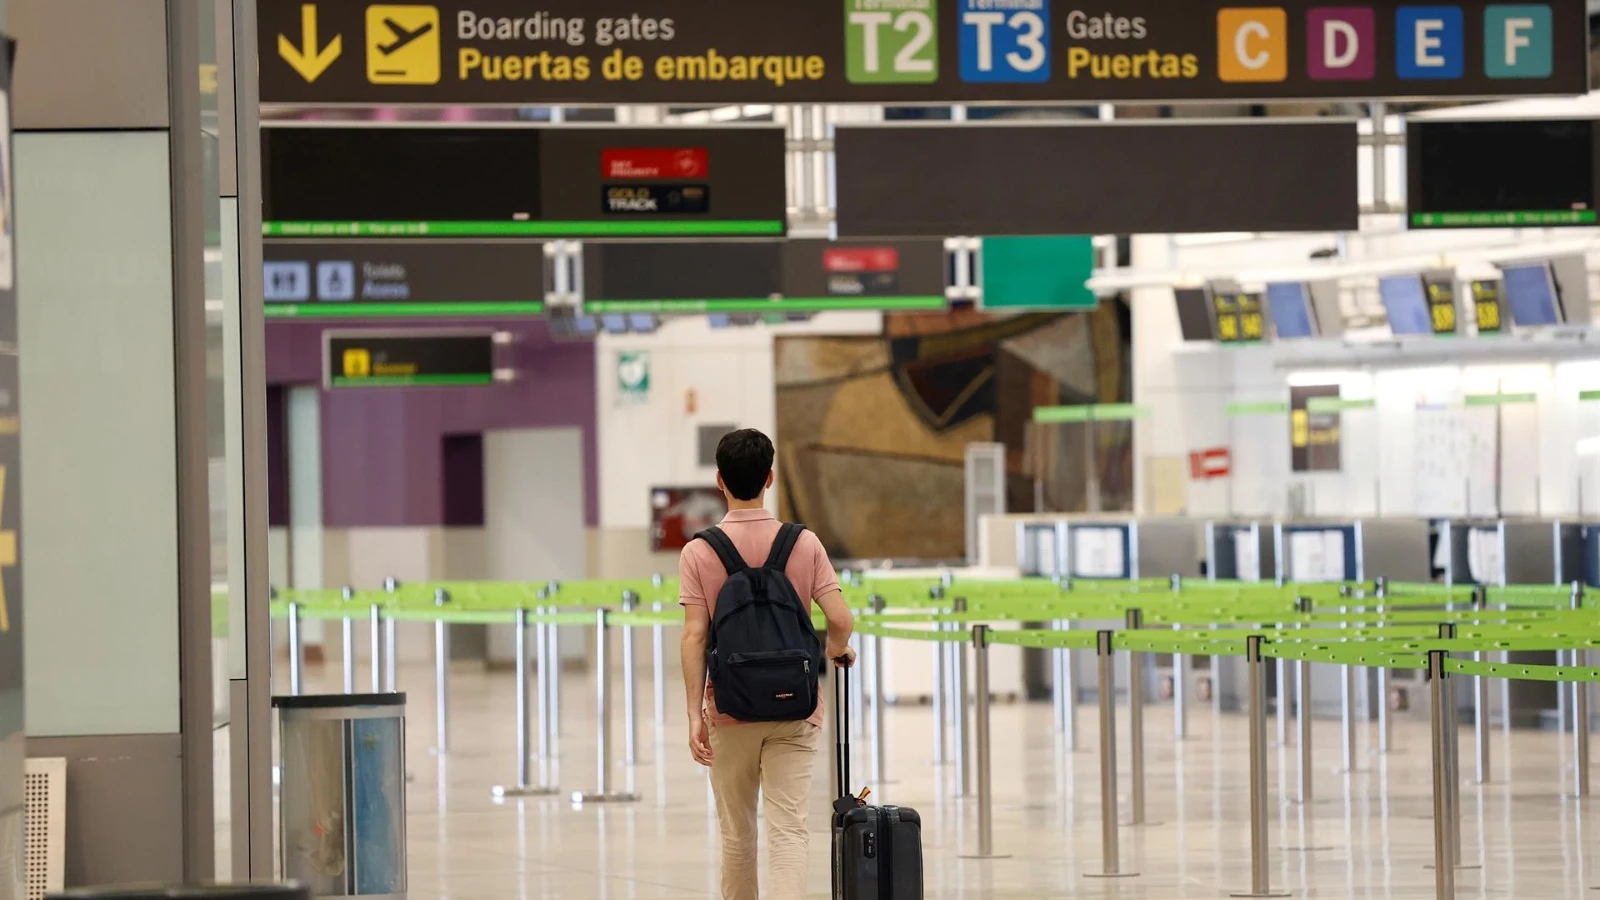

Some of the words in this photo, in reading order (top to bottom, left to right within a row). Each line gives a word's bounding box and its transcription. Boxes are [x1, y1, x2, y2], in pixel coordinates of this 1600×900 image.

[457, 10, 586, 46] Boarding
[595, 12, 676, 46] gates
[849, 10, 934, 73] T2
[963, 11, 1047, 73] T3
[1066, 10, 1147, 39] Gates
[1234, 20, 1270, 70] C
[1323, 19, 1359, 68] D
[1415, 19, 1445, 67] E
[1504, 17, 1534, 66] F
[458, 47, 591, 81] Puertas
[601, 48, 644, 81] de
[655, 48, 825, 87] embarque
[1067, 47, 1199, 79] Puertas
[608, 188, 650, 198] GOLD
[608, 198, 657, 211] TRACK
